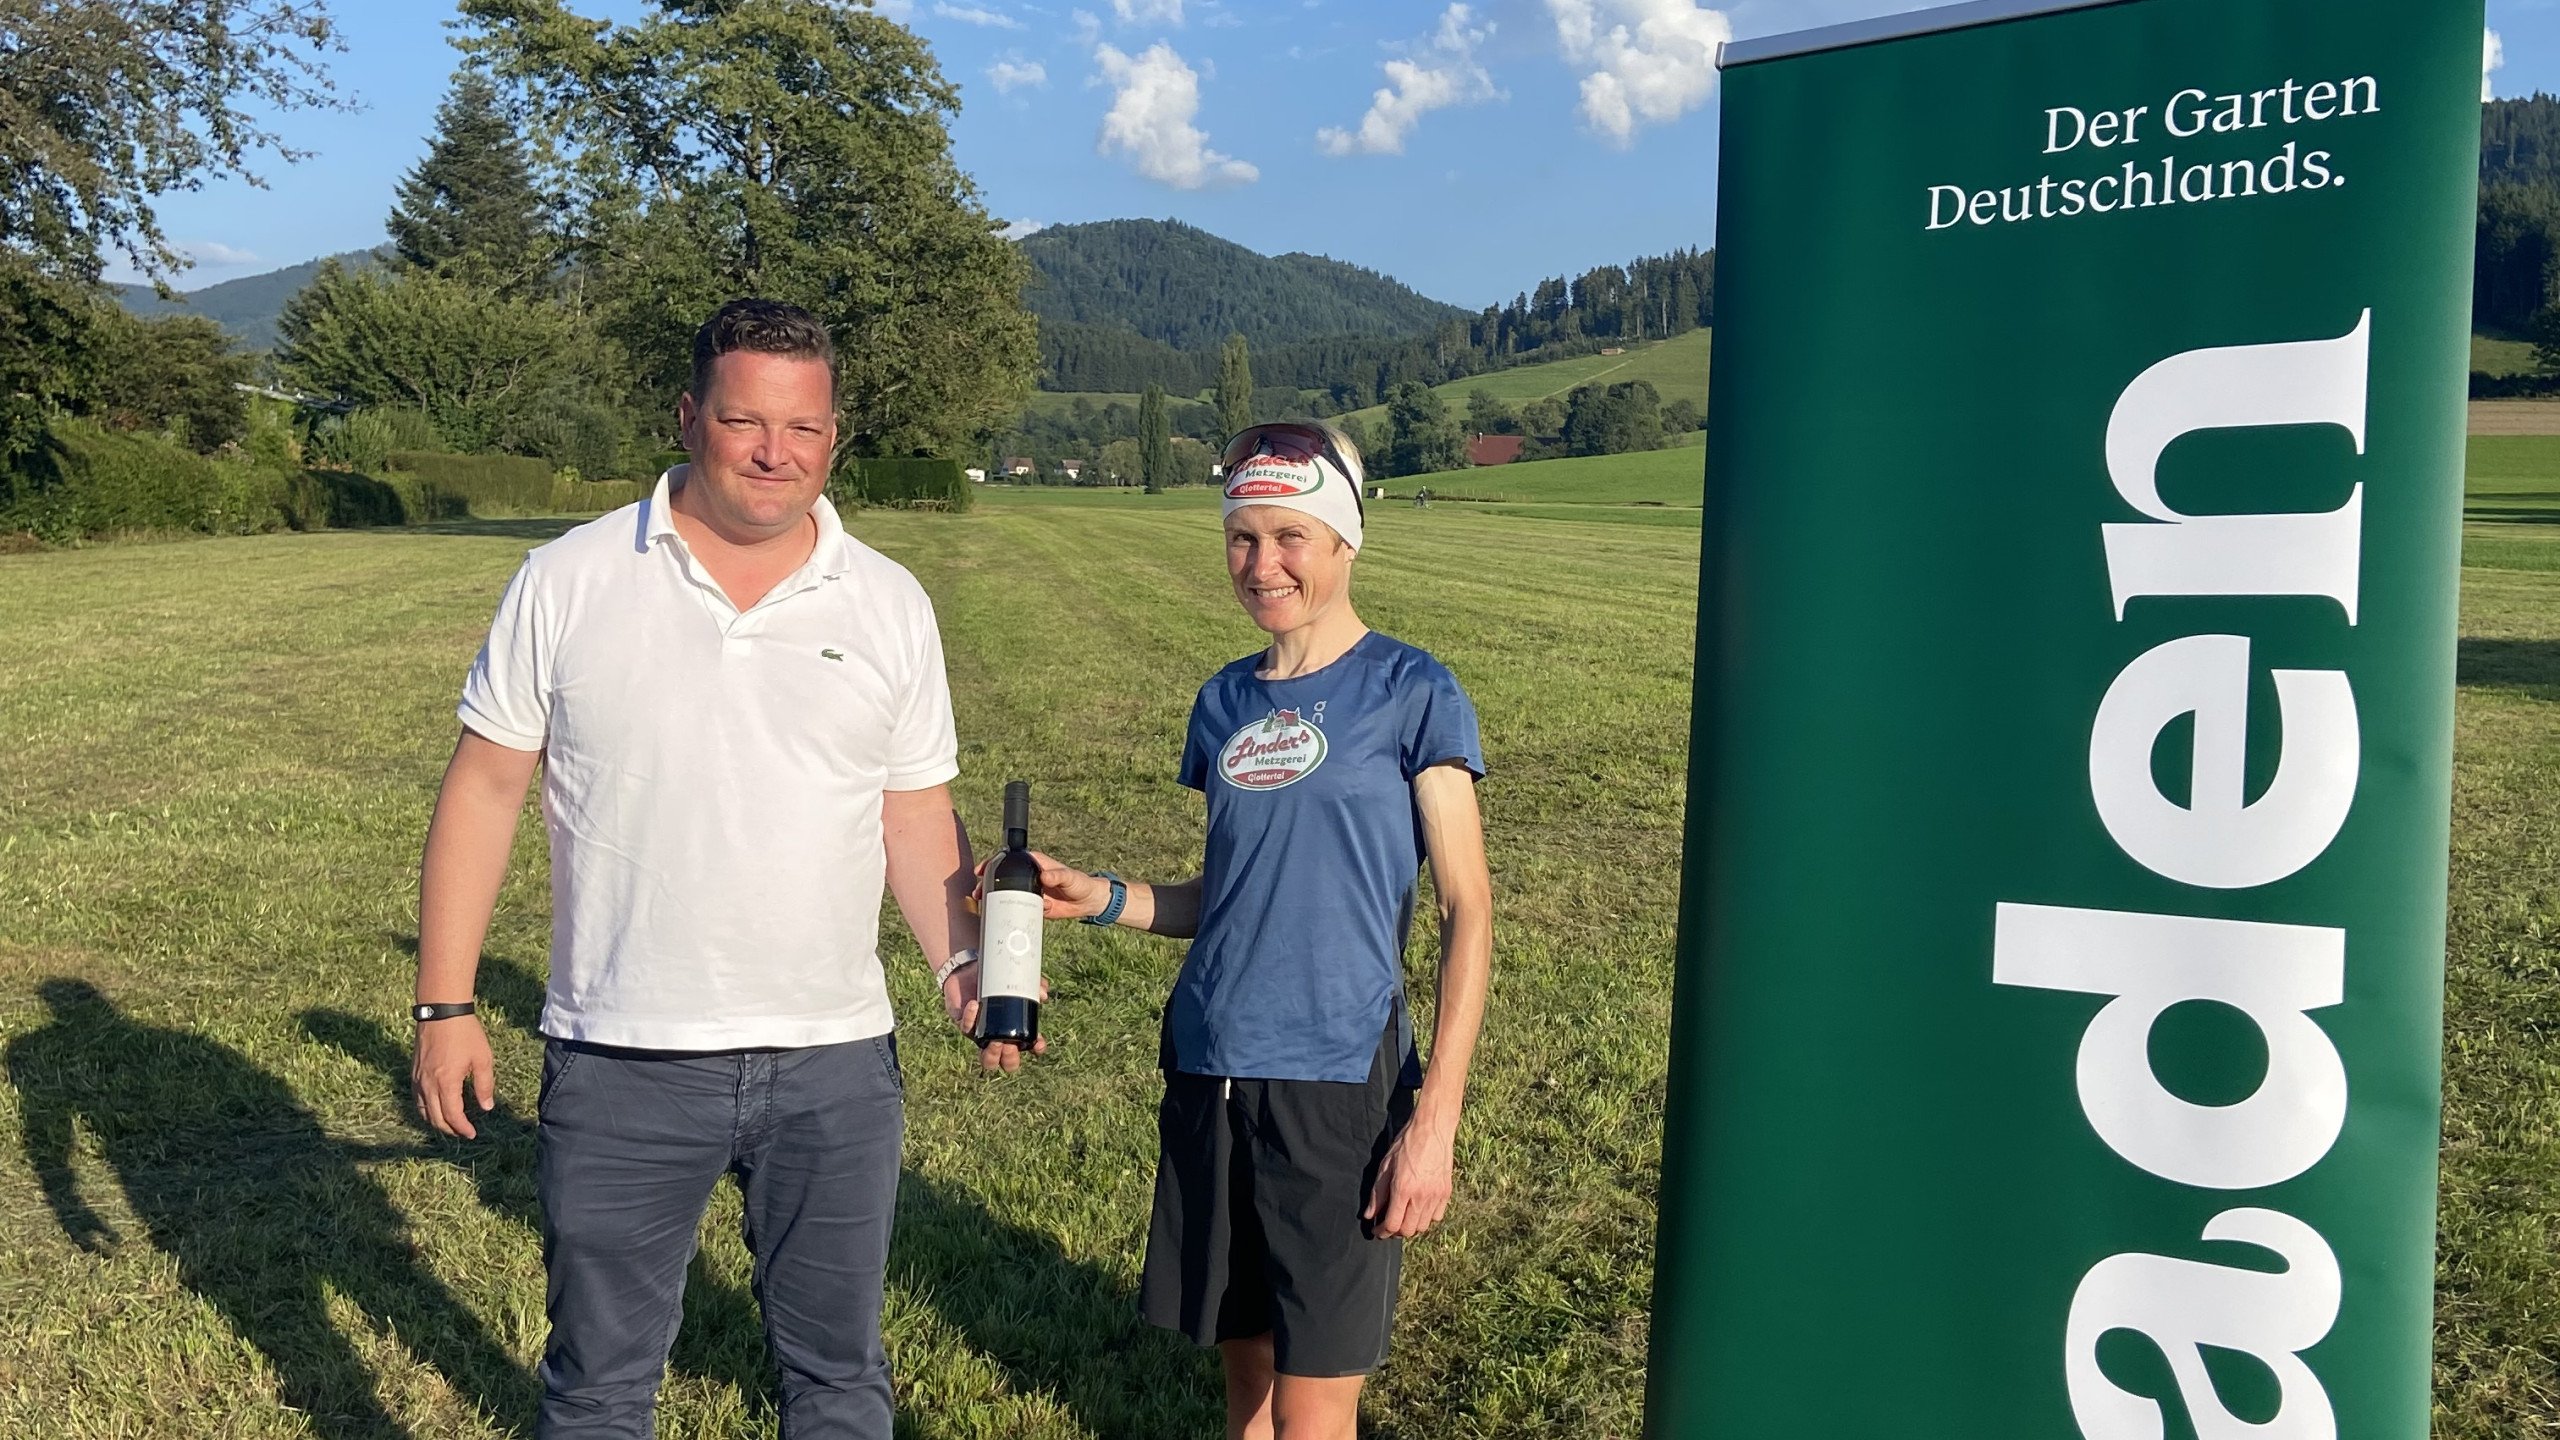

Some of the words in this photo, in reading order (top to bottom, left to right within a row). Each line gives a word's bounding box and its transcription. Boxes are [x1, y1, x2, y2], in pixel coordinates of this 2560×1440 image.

[2042, 106, 2148, 154] Der
[2163, 74, 2381, 138] Garten
[1924, 141, 2346, 230] Deutschlands.
[1245, 469, 1307, 484] Metzgerei
[1239, 484, 1282, 494] Glottertal
[1255, 754, 1306, 767] Metzgerei
[1247, 771, 1285, 782] Glottertal
[1992, 307, 2371, 1440] aden
